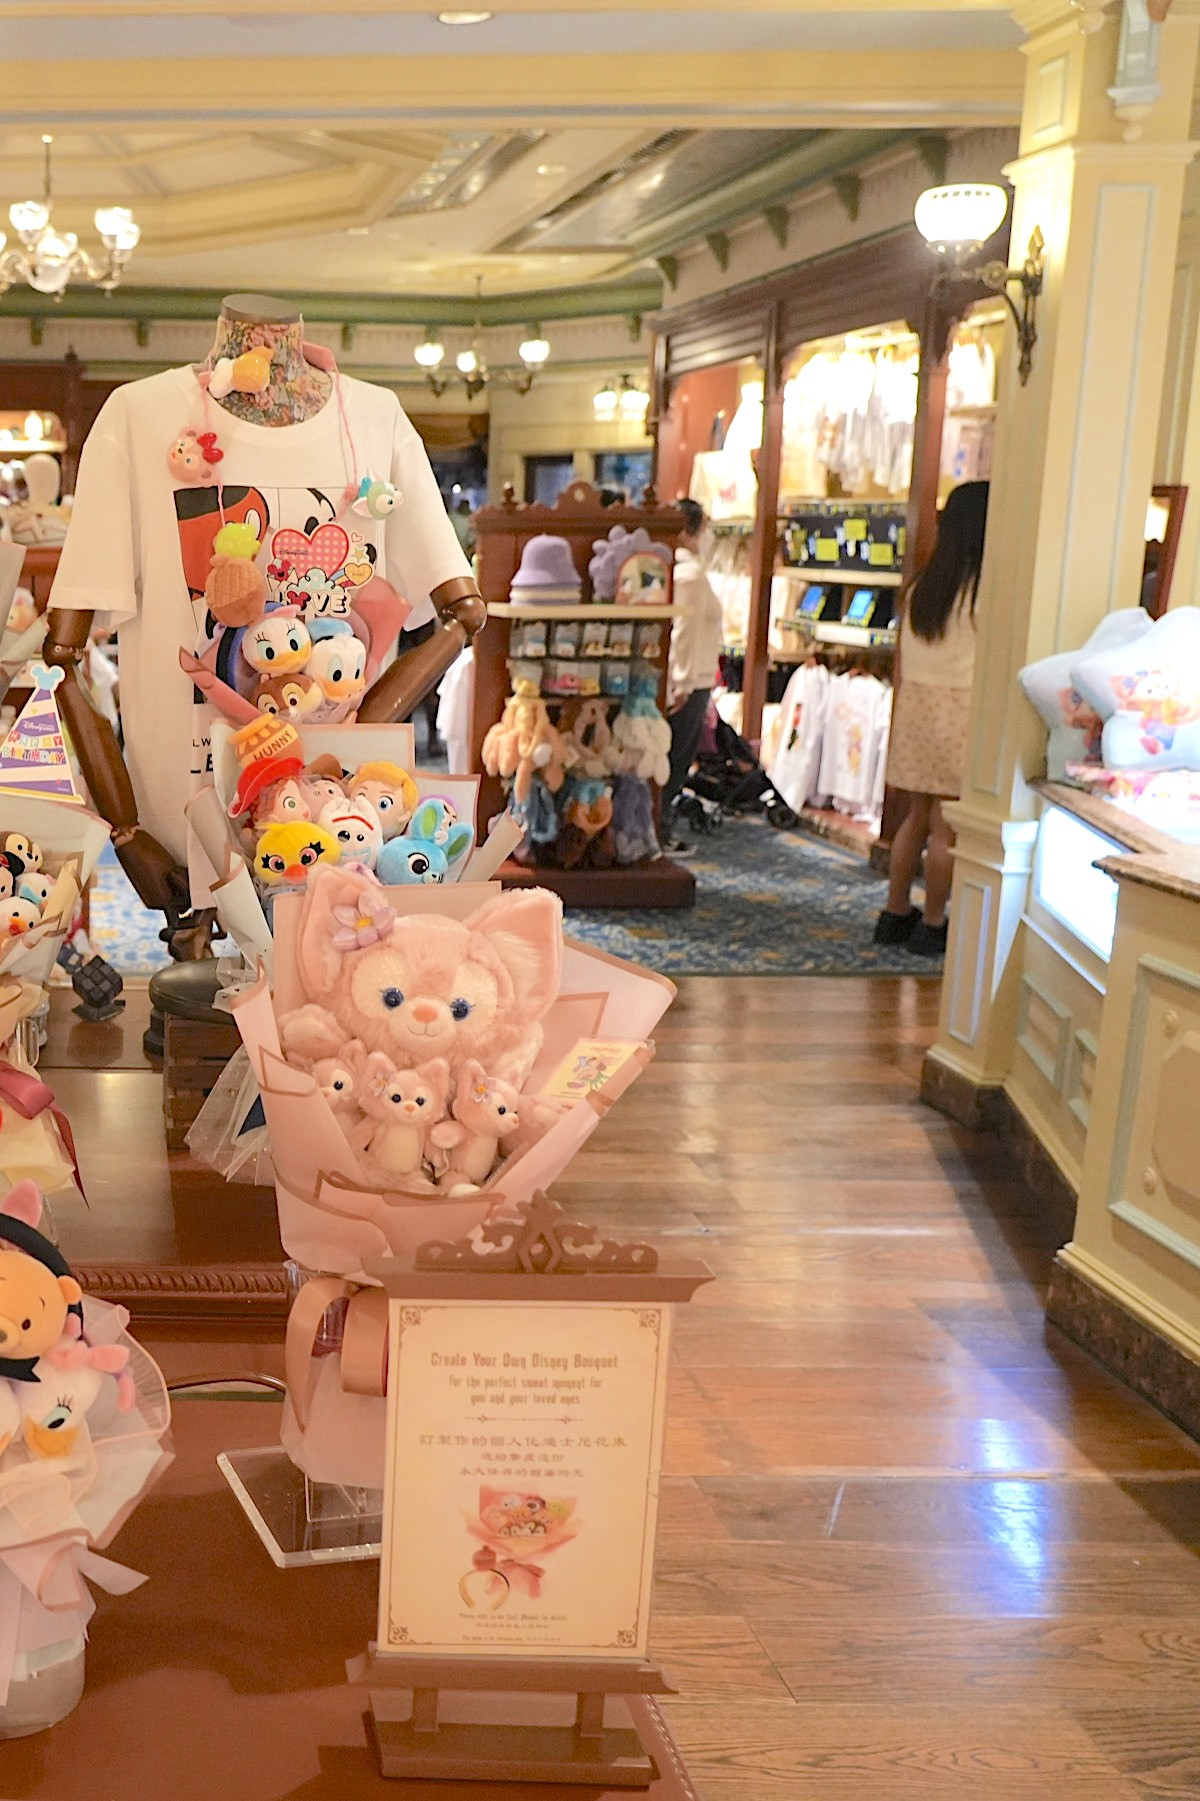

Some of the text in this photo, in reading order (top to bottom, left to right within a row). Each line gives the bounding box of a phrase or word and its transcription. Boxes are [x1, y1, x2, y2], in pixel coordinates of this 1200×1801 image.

[8, 731, 63, 748] HAPPY
[253, 730, 293, 761] HUNNY
[1, 747, 65, 764] BIRTHDAY
[430, 1351, 618, 1371] Create Your Own Disney Bouquet
[449, 1375, 602, 1391] for the perfect sweet moment for
[471, 1392, 580, 1405] you and your loved ones
